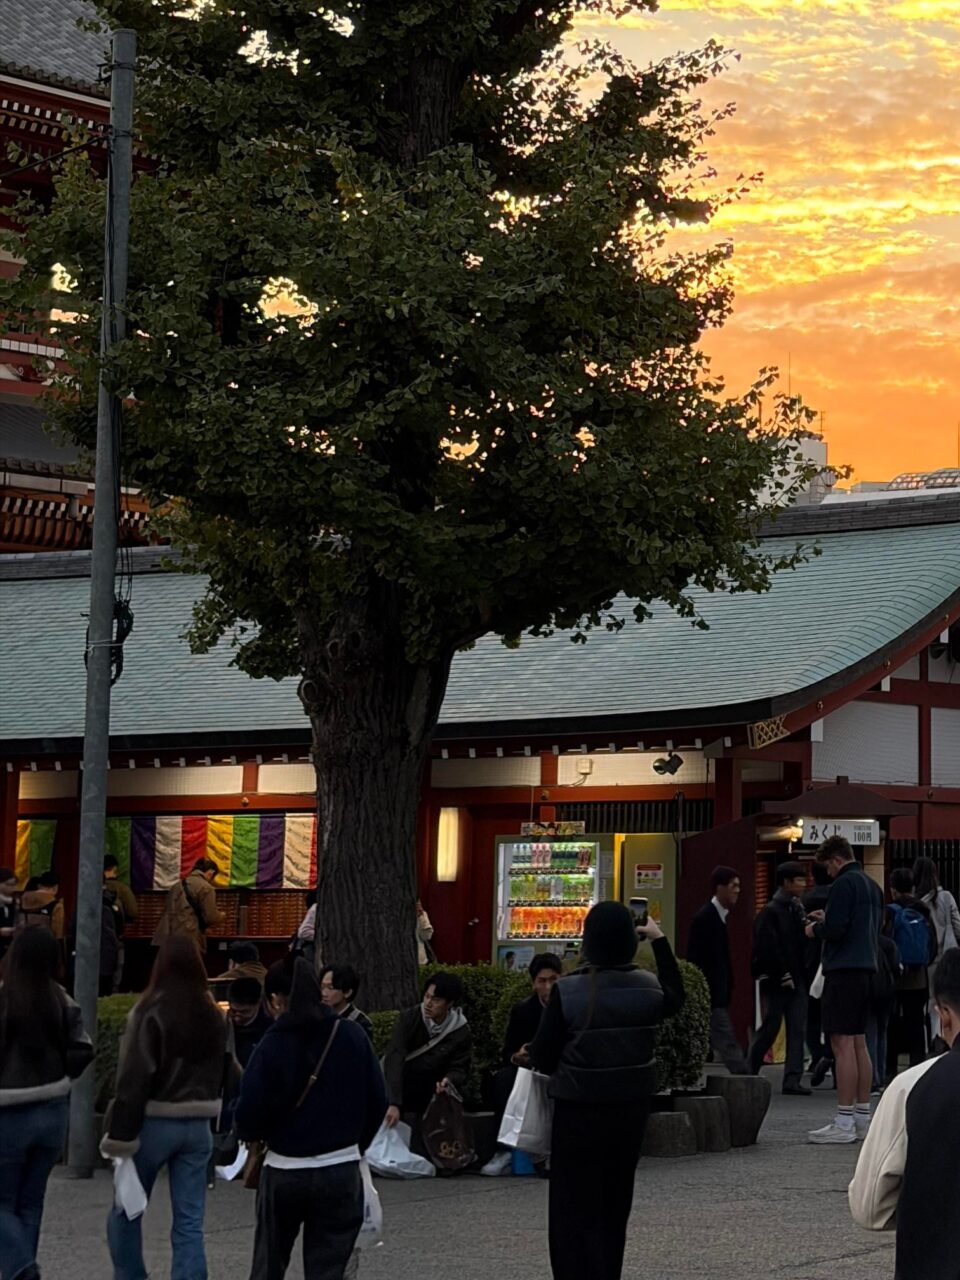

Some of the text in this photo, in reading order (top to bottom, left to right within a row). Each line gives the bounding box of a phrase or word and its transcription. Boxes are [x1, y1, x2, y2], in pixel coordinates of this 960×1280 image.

[809, 823, 842, 842] みくじ
[854, 831, 872, 842] 100円
